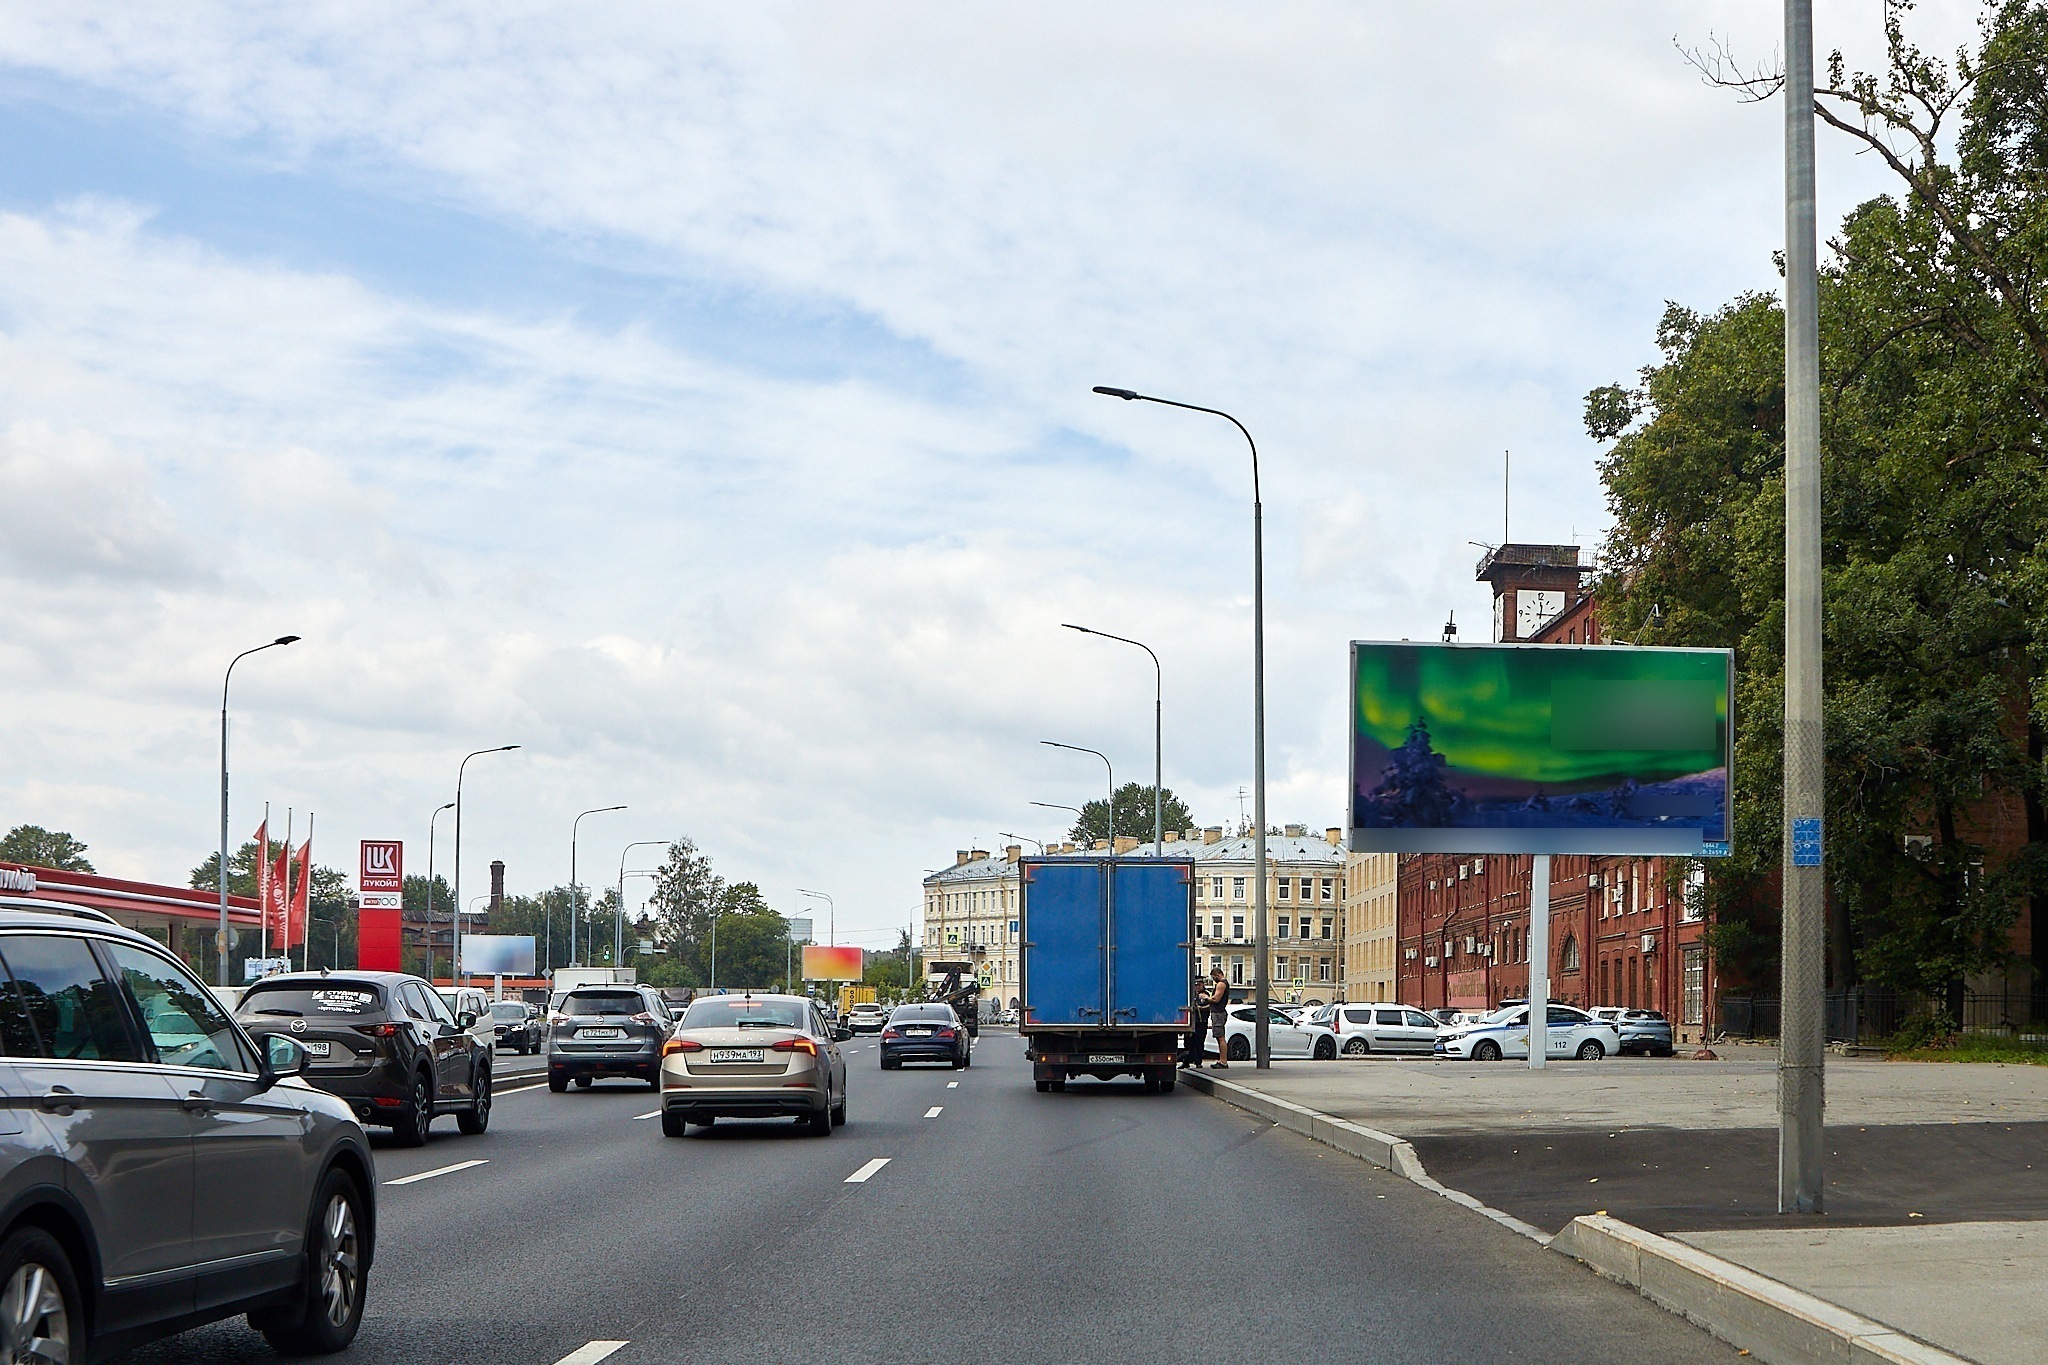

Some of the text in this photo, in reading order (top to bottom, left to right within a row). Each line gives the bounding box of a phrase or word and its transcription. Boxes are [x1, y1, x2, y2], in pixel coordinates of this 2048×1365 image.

[1537, 592, 1545, 601] 12
[1518, 609, 1524, 618] 9
[362, 878, 399, 887] ЛУКОЙЛ
[312, 1043, 328, 1052] 198
[1554, 1041, 1567, 1049] 112
[713, 1050, 747, 1060] Н939МА
